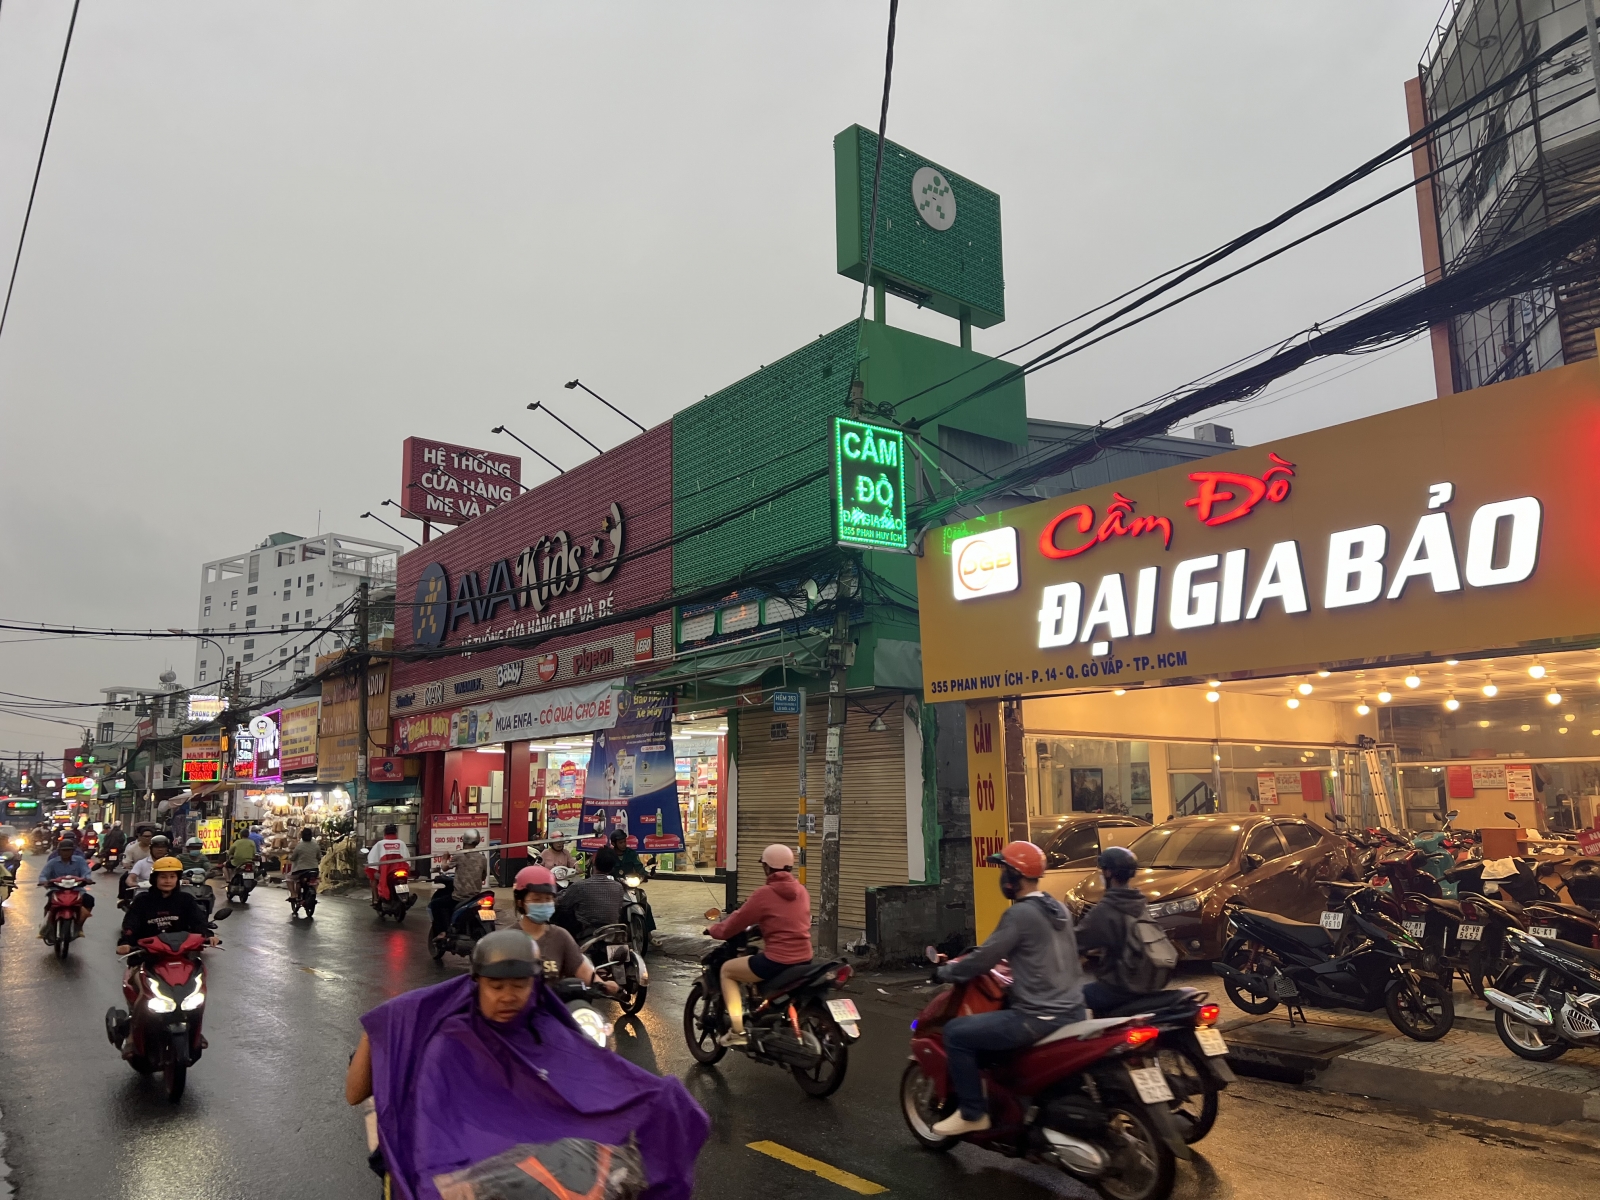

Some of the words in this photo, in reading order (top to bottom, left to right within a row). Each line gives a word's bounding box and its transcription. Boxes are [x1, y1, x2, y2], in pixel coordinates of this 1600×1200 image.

[424, 447, 446, 469] HỆ
[451, 452, 511, 477] THỐNG
[421, 471, 459, 492] CỬA
[463, 479, 512, 501] HÀNG
[426, 495, 453, 517] MẸ
[1039, 492, 1172, 559] Cầm
[1185, 452, 1296, 526] Đồ
[856, 528, 875, 539] PHAN
[876, 531, 890, 541] HUY
[1038, 566, 1160, 656] ĐẠI
[1170, 540, 1309, 630] GIA
[1324, 481, 1542, 609] BẢO
[931, 681, 949, 694] 355
[951, 676, 978, 692] PHAN
[980, 674, 1001, 689] HUY
[1004, 669, 1024, 687] ÍCH
[1045, 668, 1057, 682] 14
[1081, 658, 1099, 678] GÒ
[1100, 655, 1123, 675] VẤP
[1158, 651, 1188, 670] HCM
[495, 717, 511, 731] MUA
[513, 712, 533, 729] ENFA
[540, 704, 553, 725] CÓ
[554, 701, 573, 724] QUÀ
[575, 702, 596, 721] CHO
[598, 694, 612, 717] BÉ
[188, 771, 213, 780] NAM
